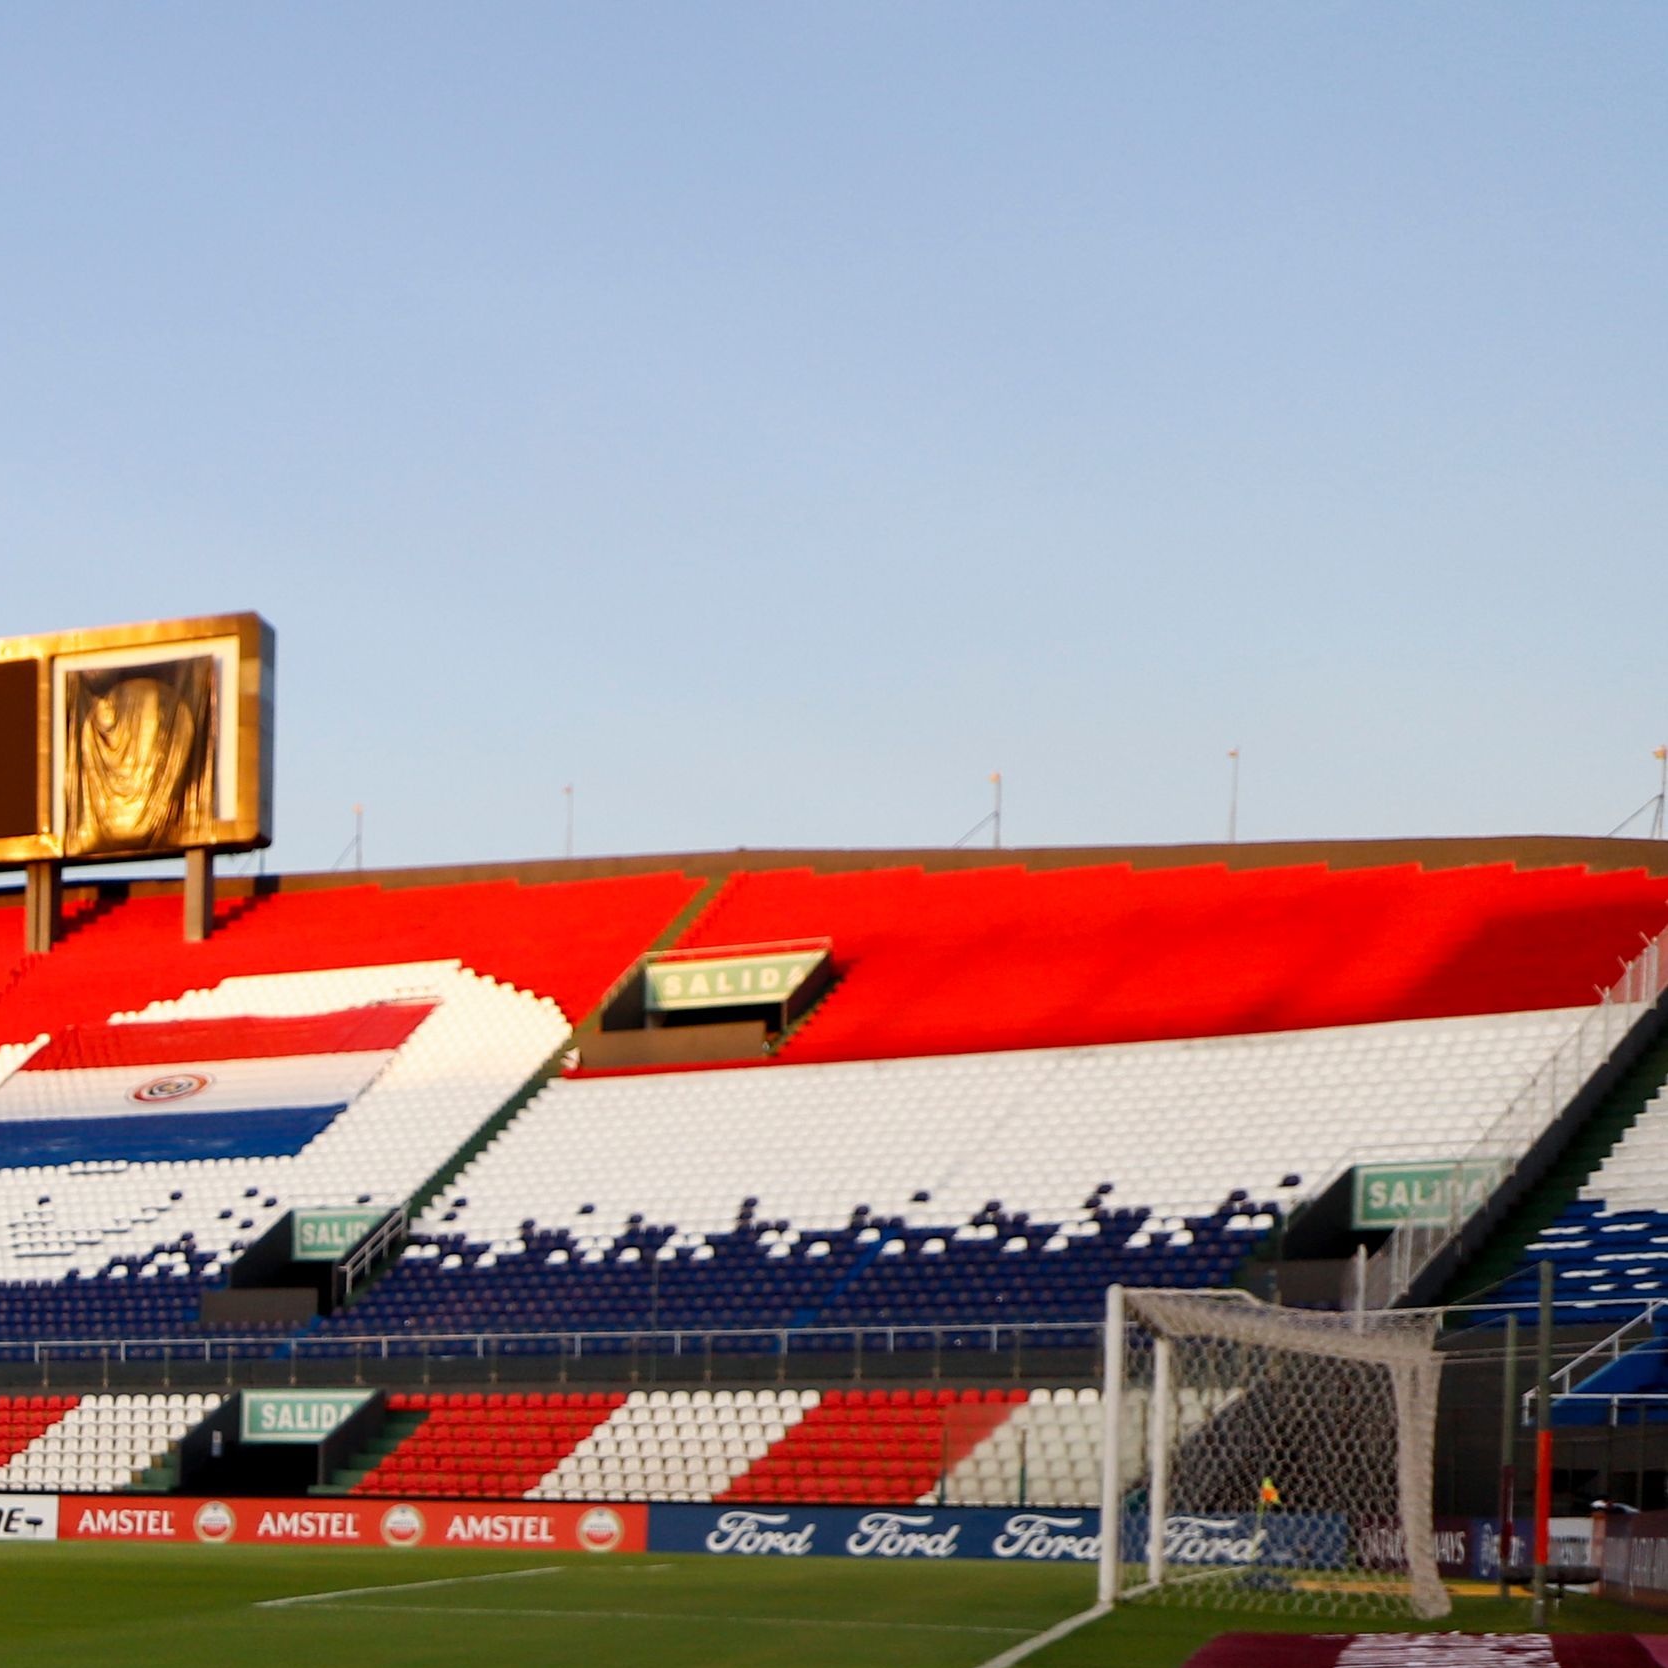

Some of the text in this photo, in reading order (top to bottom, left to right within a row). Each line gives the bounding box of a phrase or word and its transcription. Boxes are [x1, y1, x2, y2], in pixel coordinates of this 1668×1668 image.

[301, 1220, 369, 1246] SALID
[77, 1508, 175, 1536] AMSTEL
[257, 1512, 359, 1539] AMSTEL
[446, 1515, 555, 1543] AMSTEL
[705, 1511, 816, 1554] Ford
[846, 1512, 961, 1557] Ford
[1145, 1516, 1269, 1562] Ford
